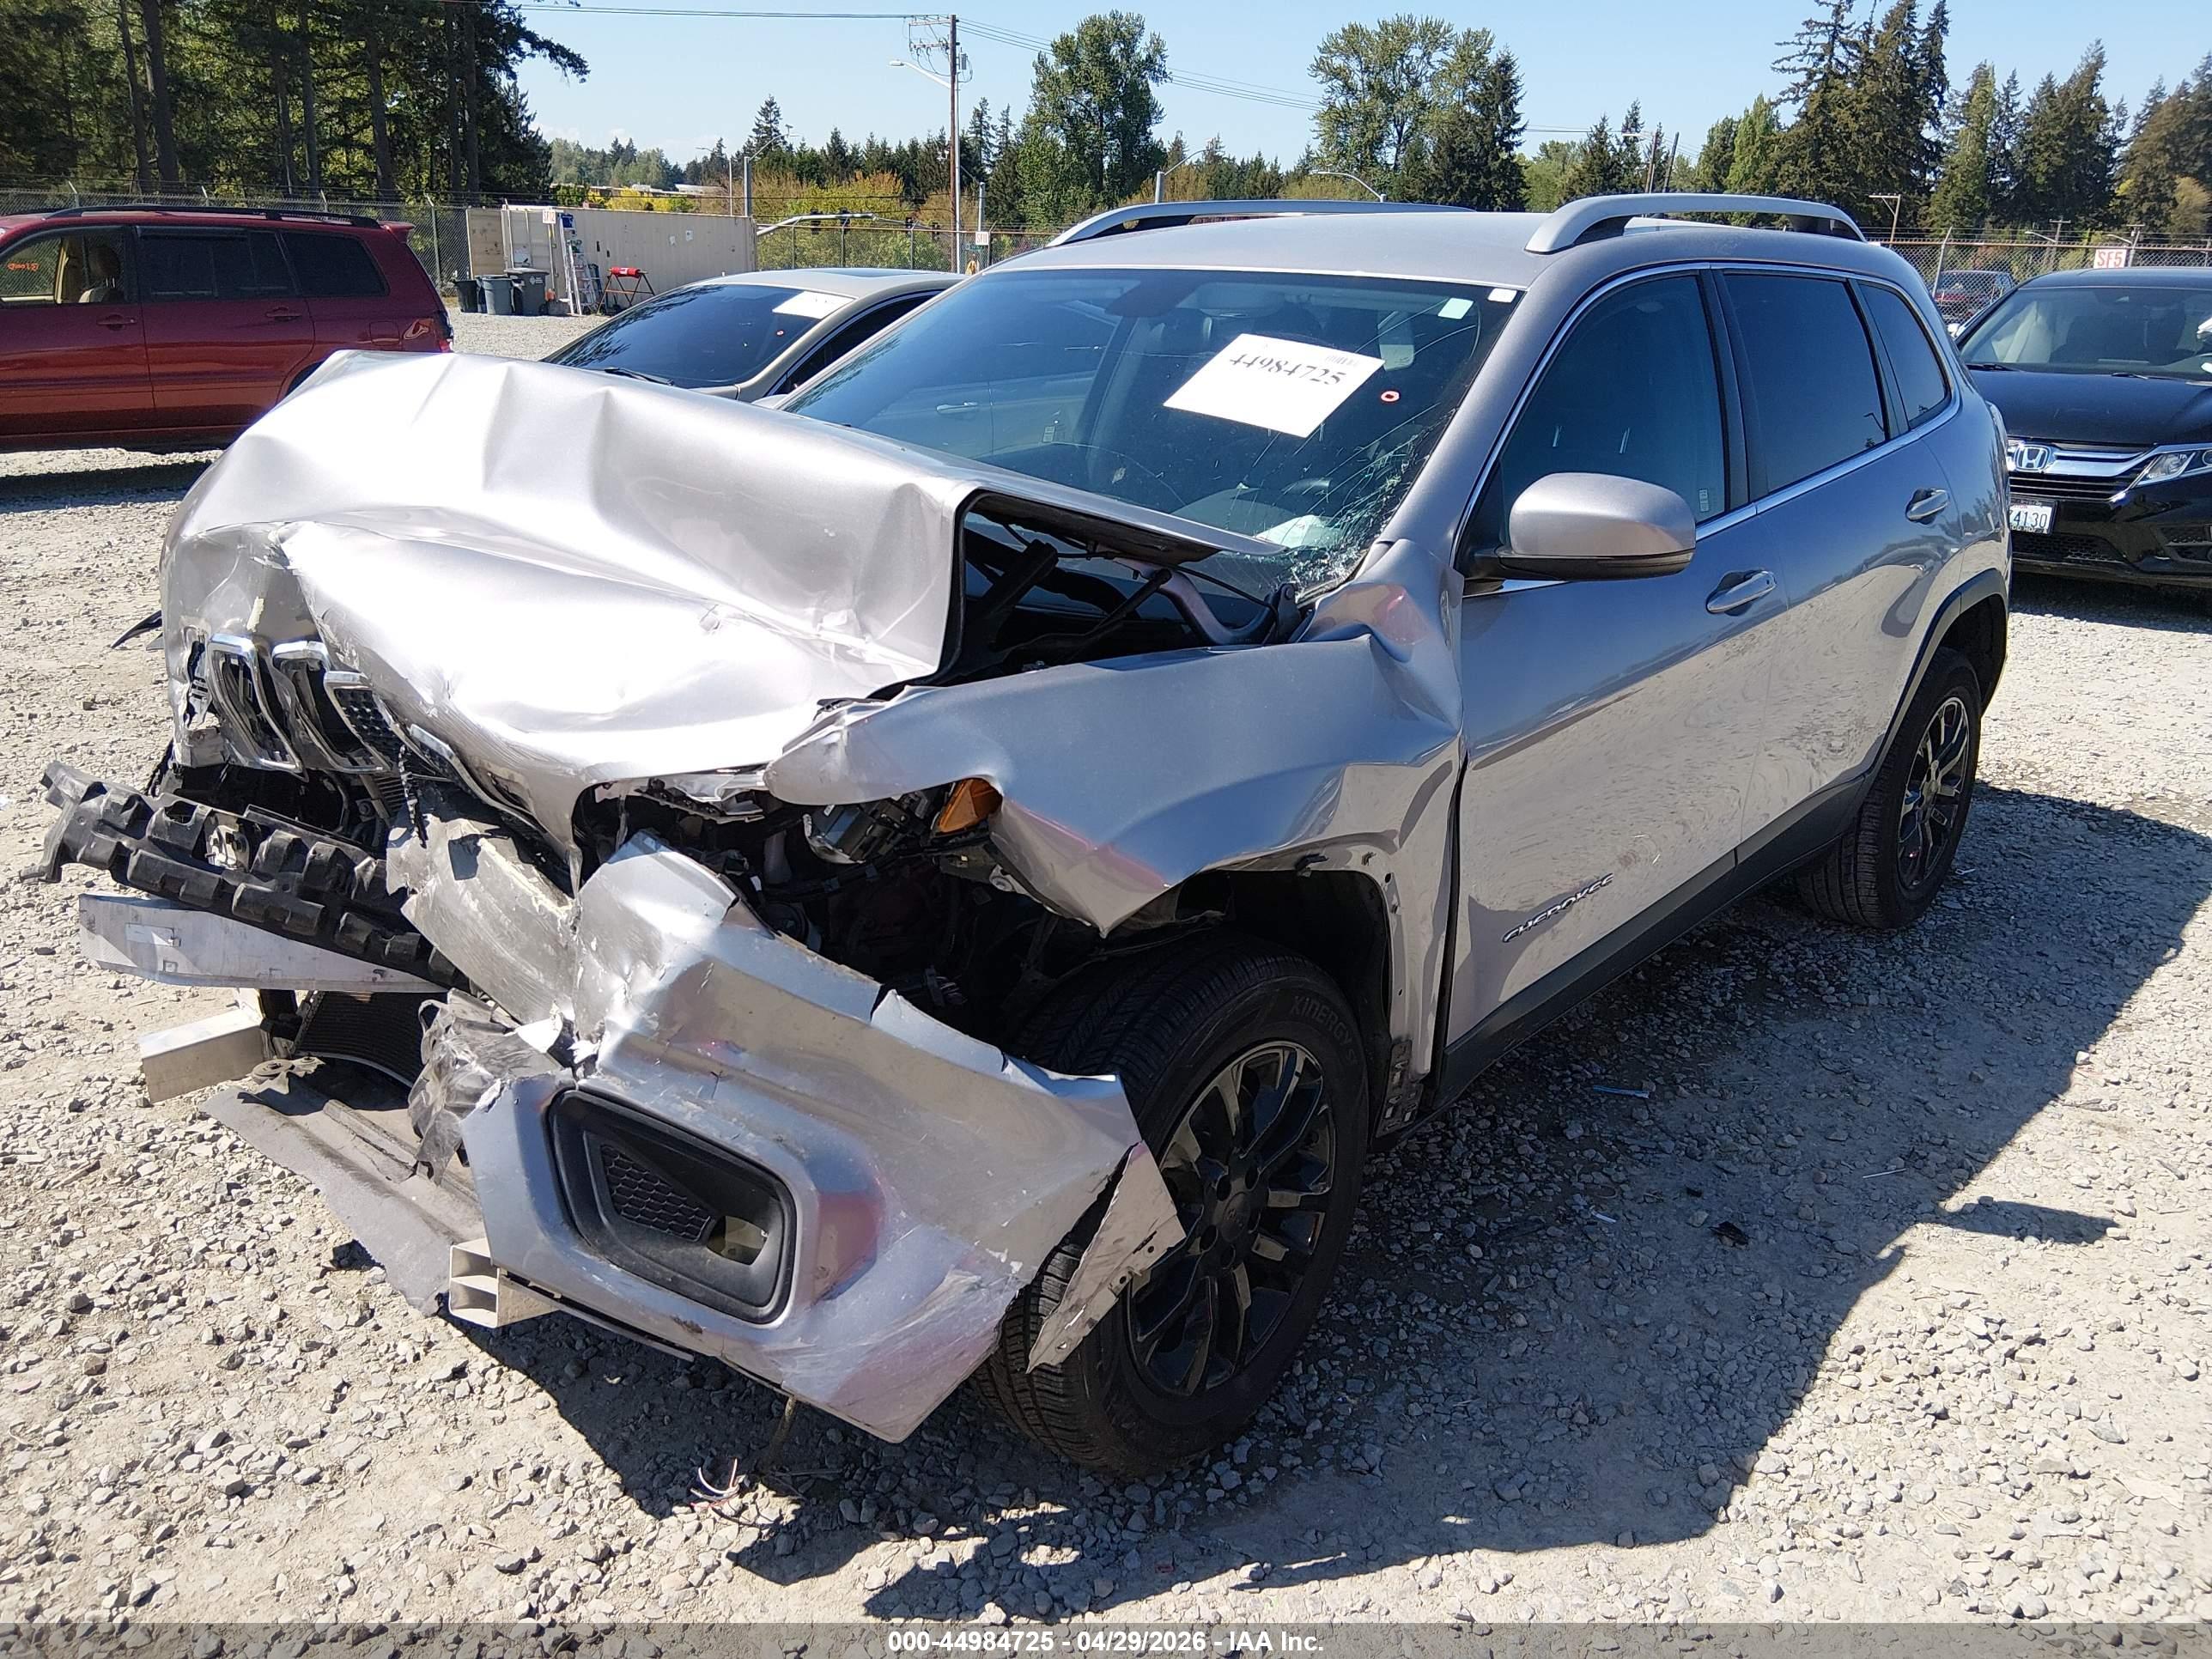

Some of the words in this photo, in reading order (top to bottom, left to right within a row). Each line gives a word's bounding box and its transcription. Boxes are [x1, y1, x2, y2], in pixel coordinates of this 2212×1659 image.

[2097, 251, 2124, 268] SF5
[1229, 353, 1347, 385] 44984725
[1502, 872, 1614, 943] CHEROKEE
